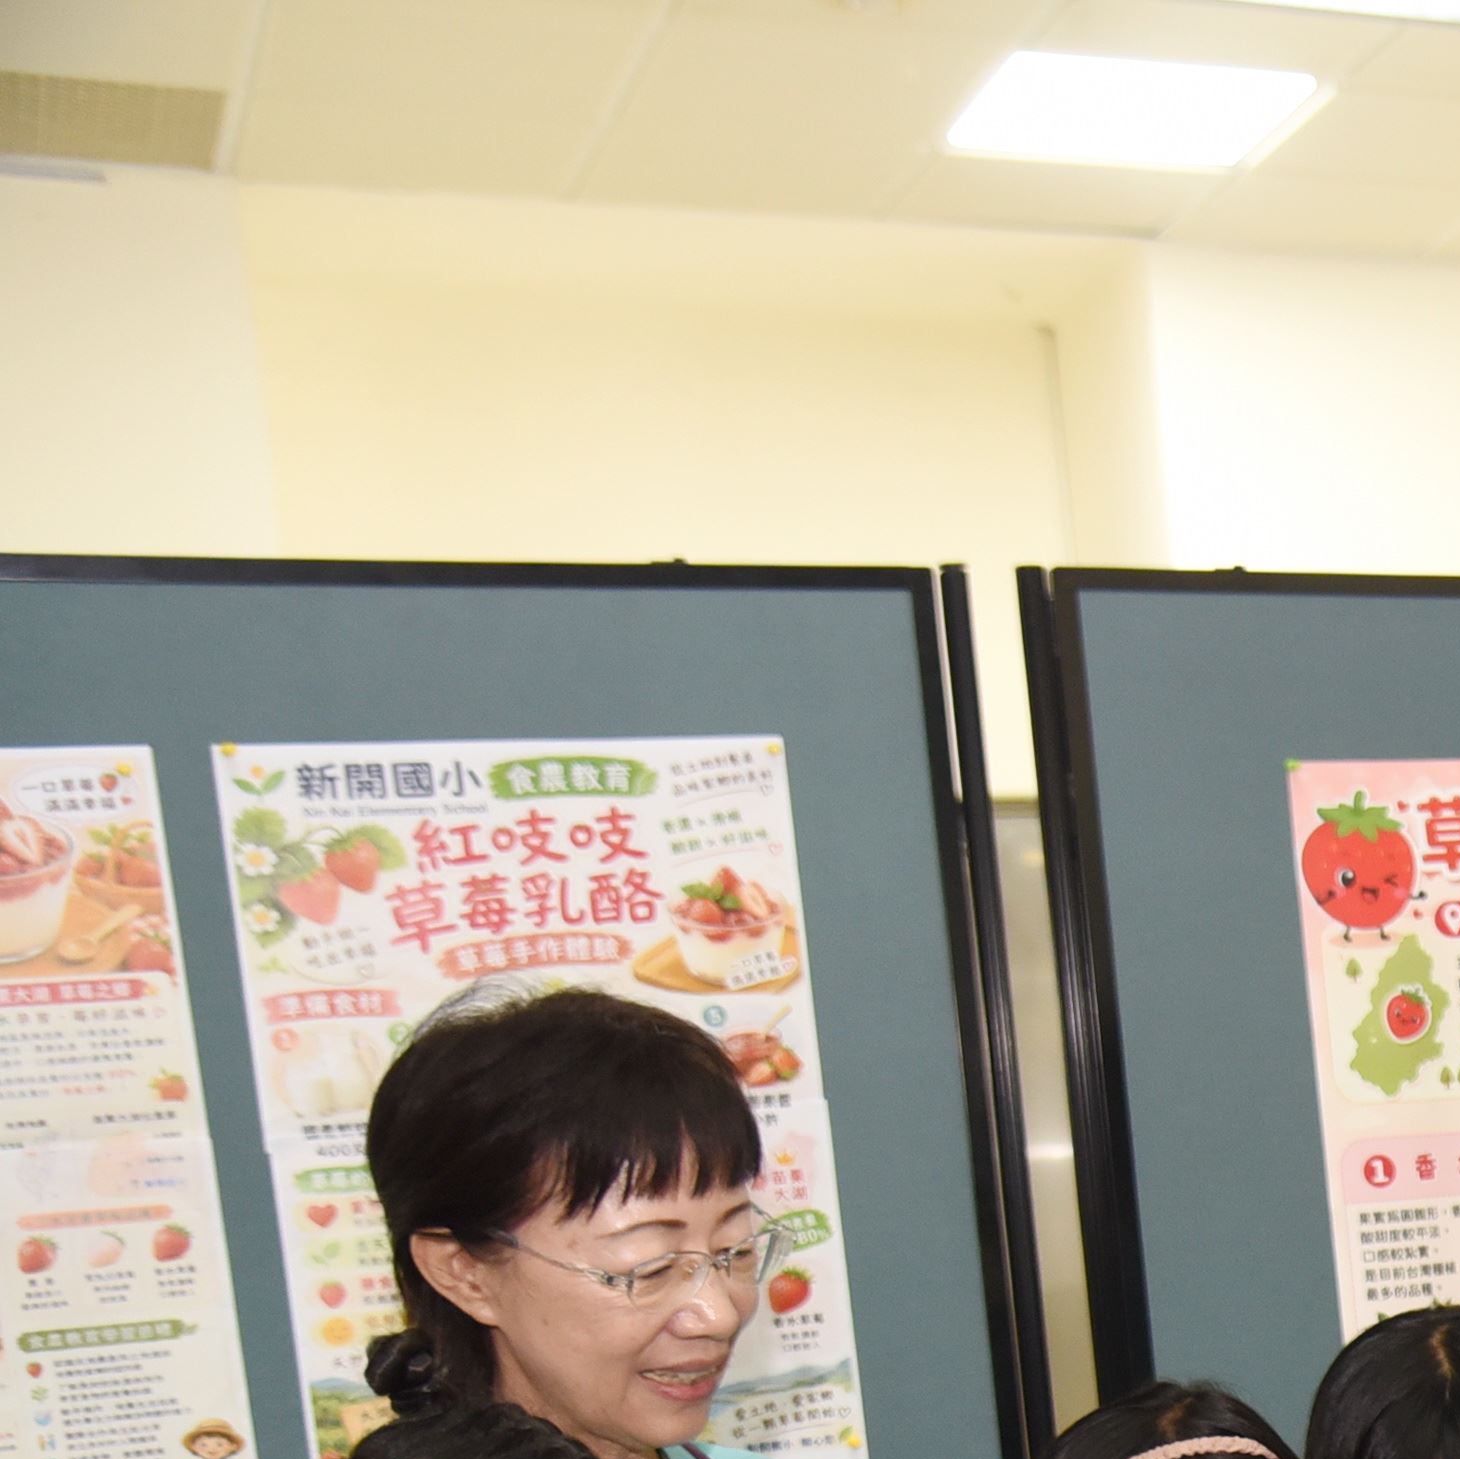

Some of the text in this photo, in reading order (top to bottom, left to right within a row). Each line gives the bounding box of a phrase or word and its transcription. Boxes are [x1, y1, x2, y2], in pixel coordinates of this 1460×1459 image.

[295, 760, 483, 800] 新開國小
[507, 760, 632, 793] 食農教育
[413, 806, 648, 873] 紅吱吱
[384, 868, 664, 954] 草莓乳酪
[1369, 1159, 1389, 1184] 1
